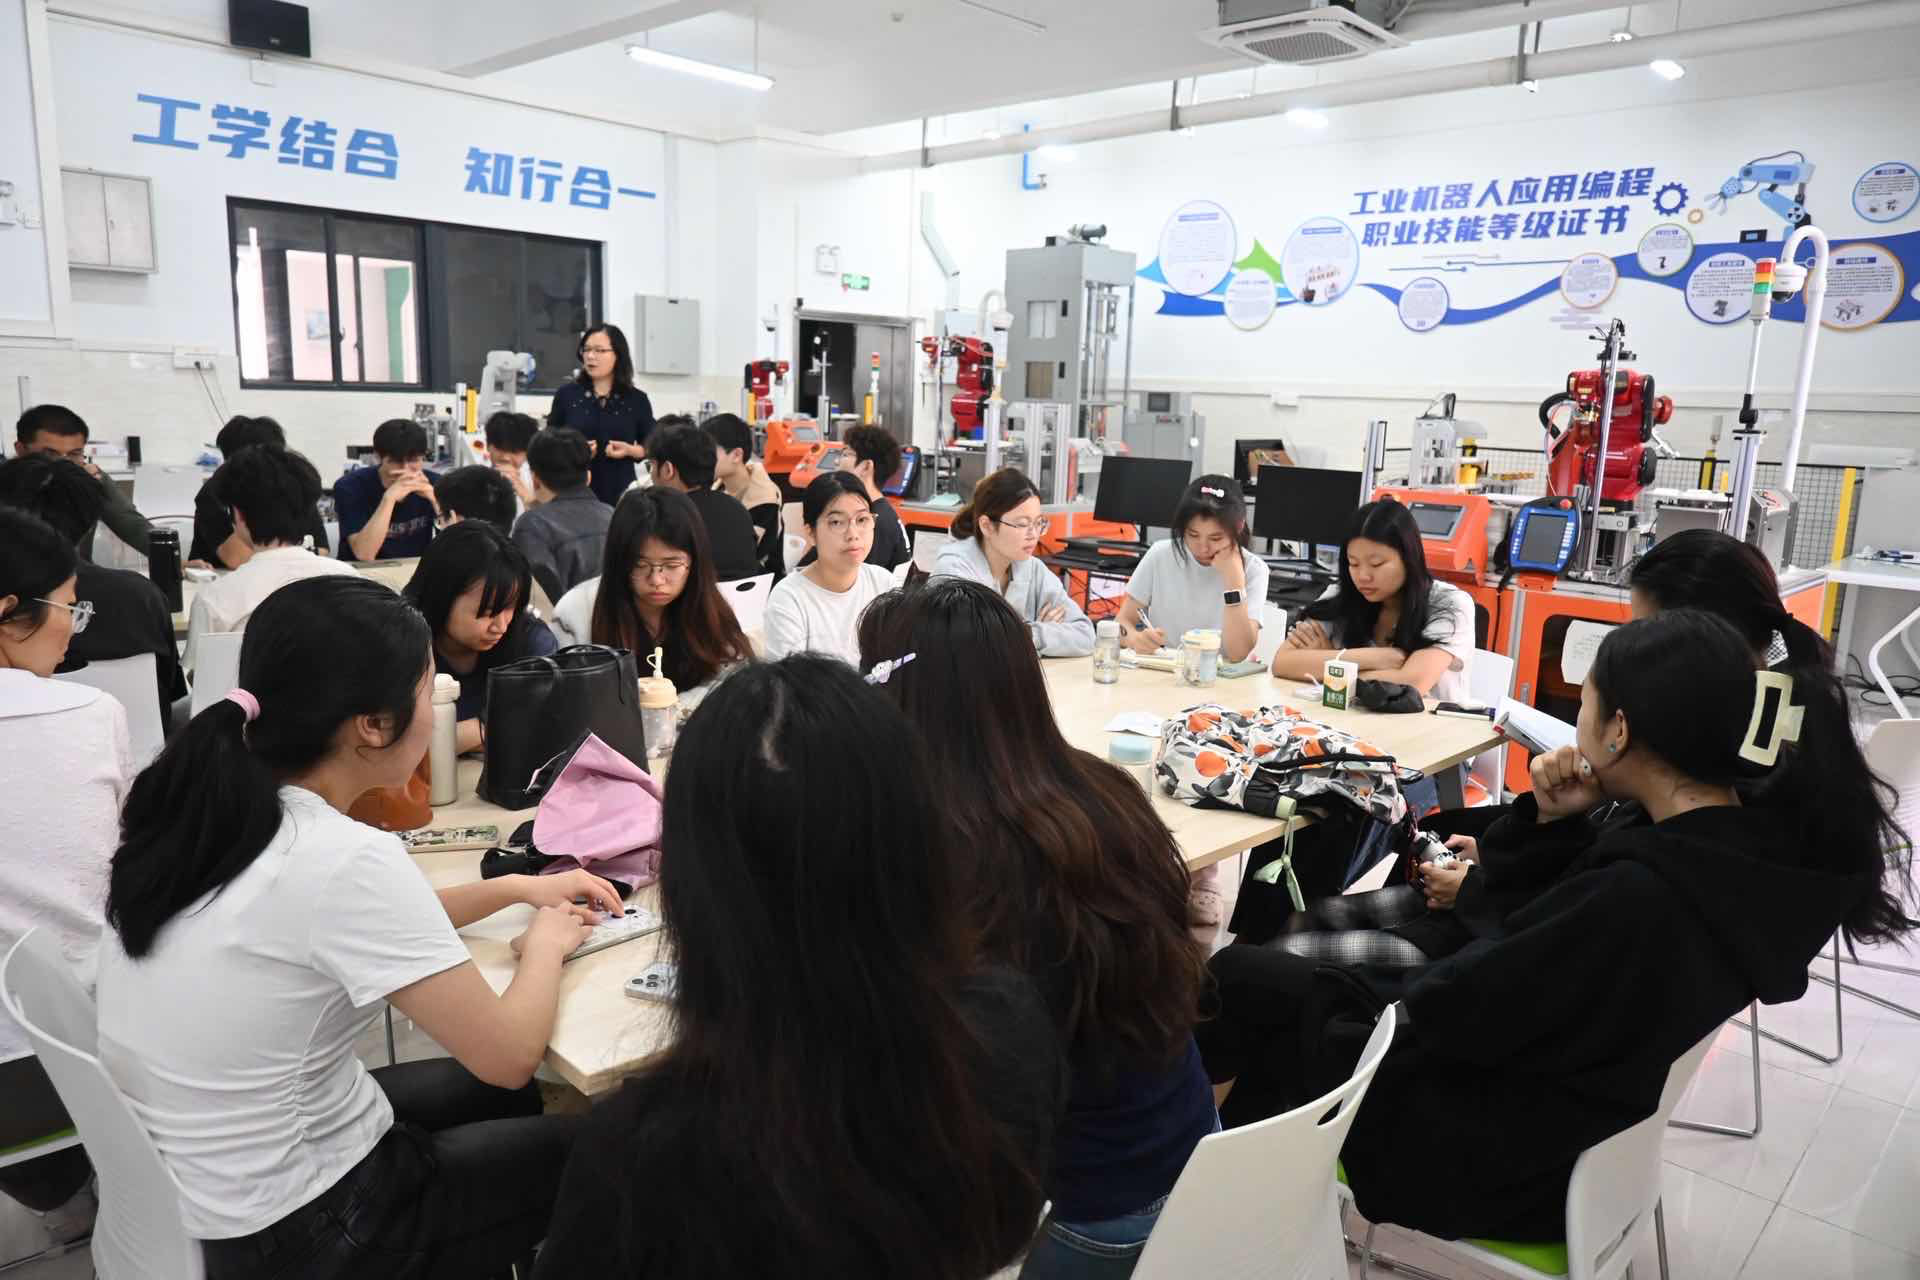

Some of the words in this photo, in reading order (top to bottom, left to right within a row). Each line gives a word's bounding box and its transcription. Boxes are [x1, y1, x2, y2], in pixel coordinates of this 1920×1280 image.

[132, 93, 399, 180] 工学结合
[464, 146, 656, 210] 知行合一
[1349, 166, 1655, 216] 工业机器人应用编程
[1361, 204, 1630, 247] 职业技能等级证书
